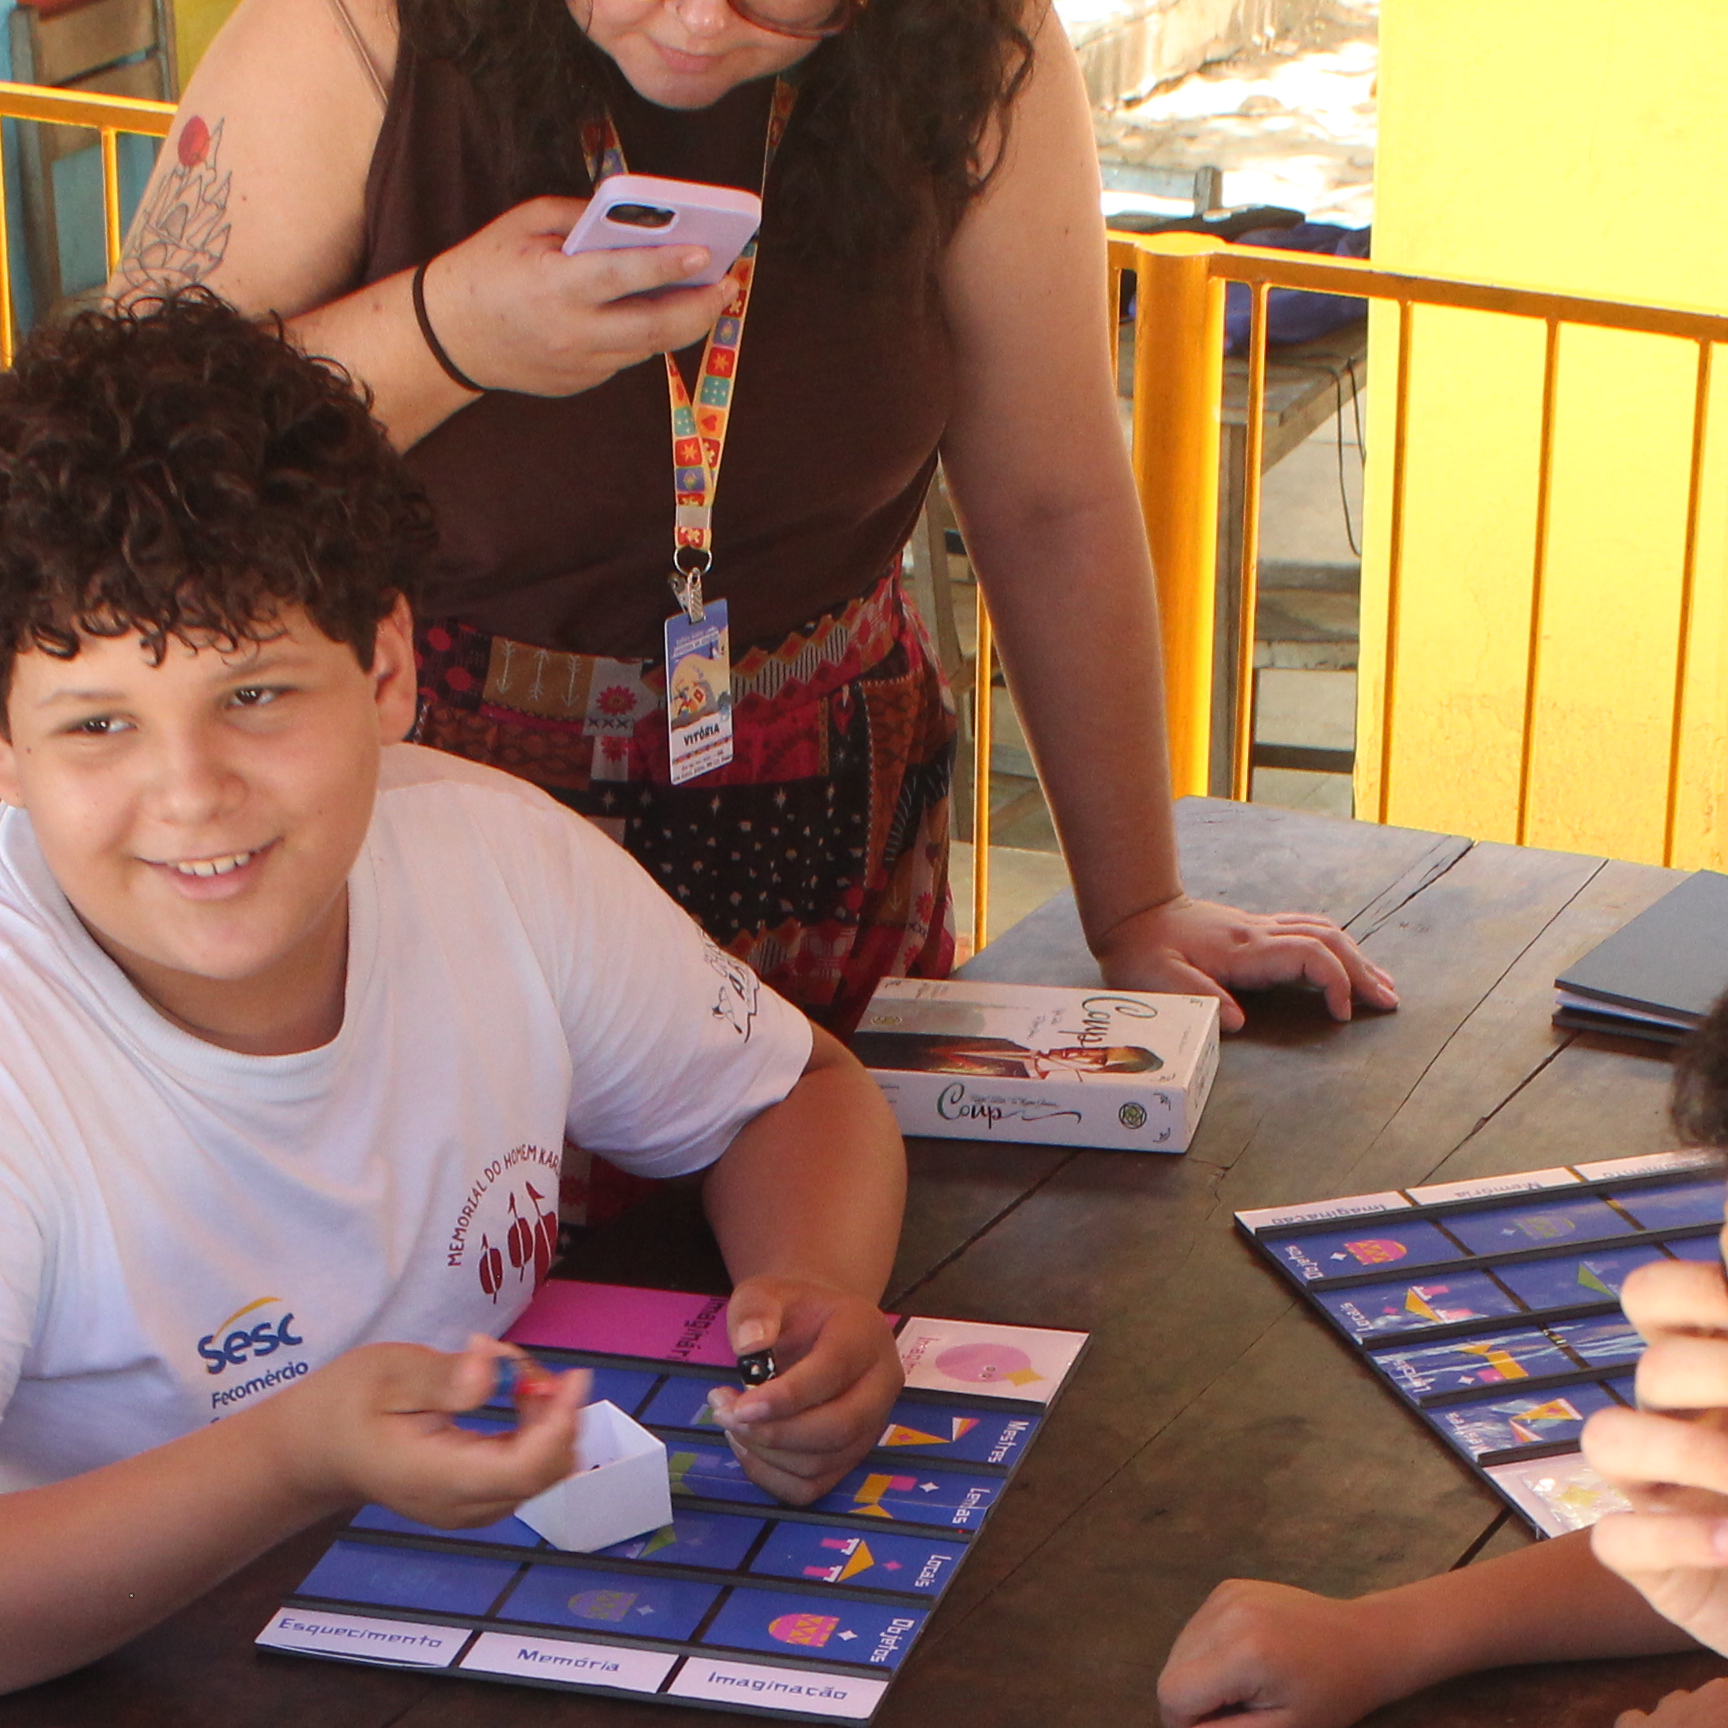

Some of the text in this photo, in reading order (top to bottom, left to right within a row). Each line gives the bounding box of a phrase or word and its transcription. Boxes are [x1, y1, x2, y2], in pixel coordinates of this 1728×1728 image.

[683, 723, 721, 747] VITÓRIA
[1057, 996, 1158, 1048] Coup
[937, 1083, 1020, 1129] Coup
[447, 1143, 560, 1268] MEMORIAL DO HOMEM KAR
[197, 1311, 303, 1375] sesc
[211, 1361, 309, 1410] Fecomércio
[986, 1419, 1030, 1465] Mestres
[914, 1552, 952, 1588] Locais
[278, 1616, 445, 1650] Esquecimento
[869, 1617, 916, 1663] Objetos
[518, 1646, 621, 1675] Memória
[706, 1670, 849, 1704] Imaginação
